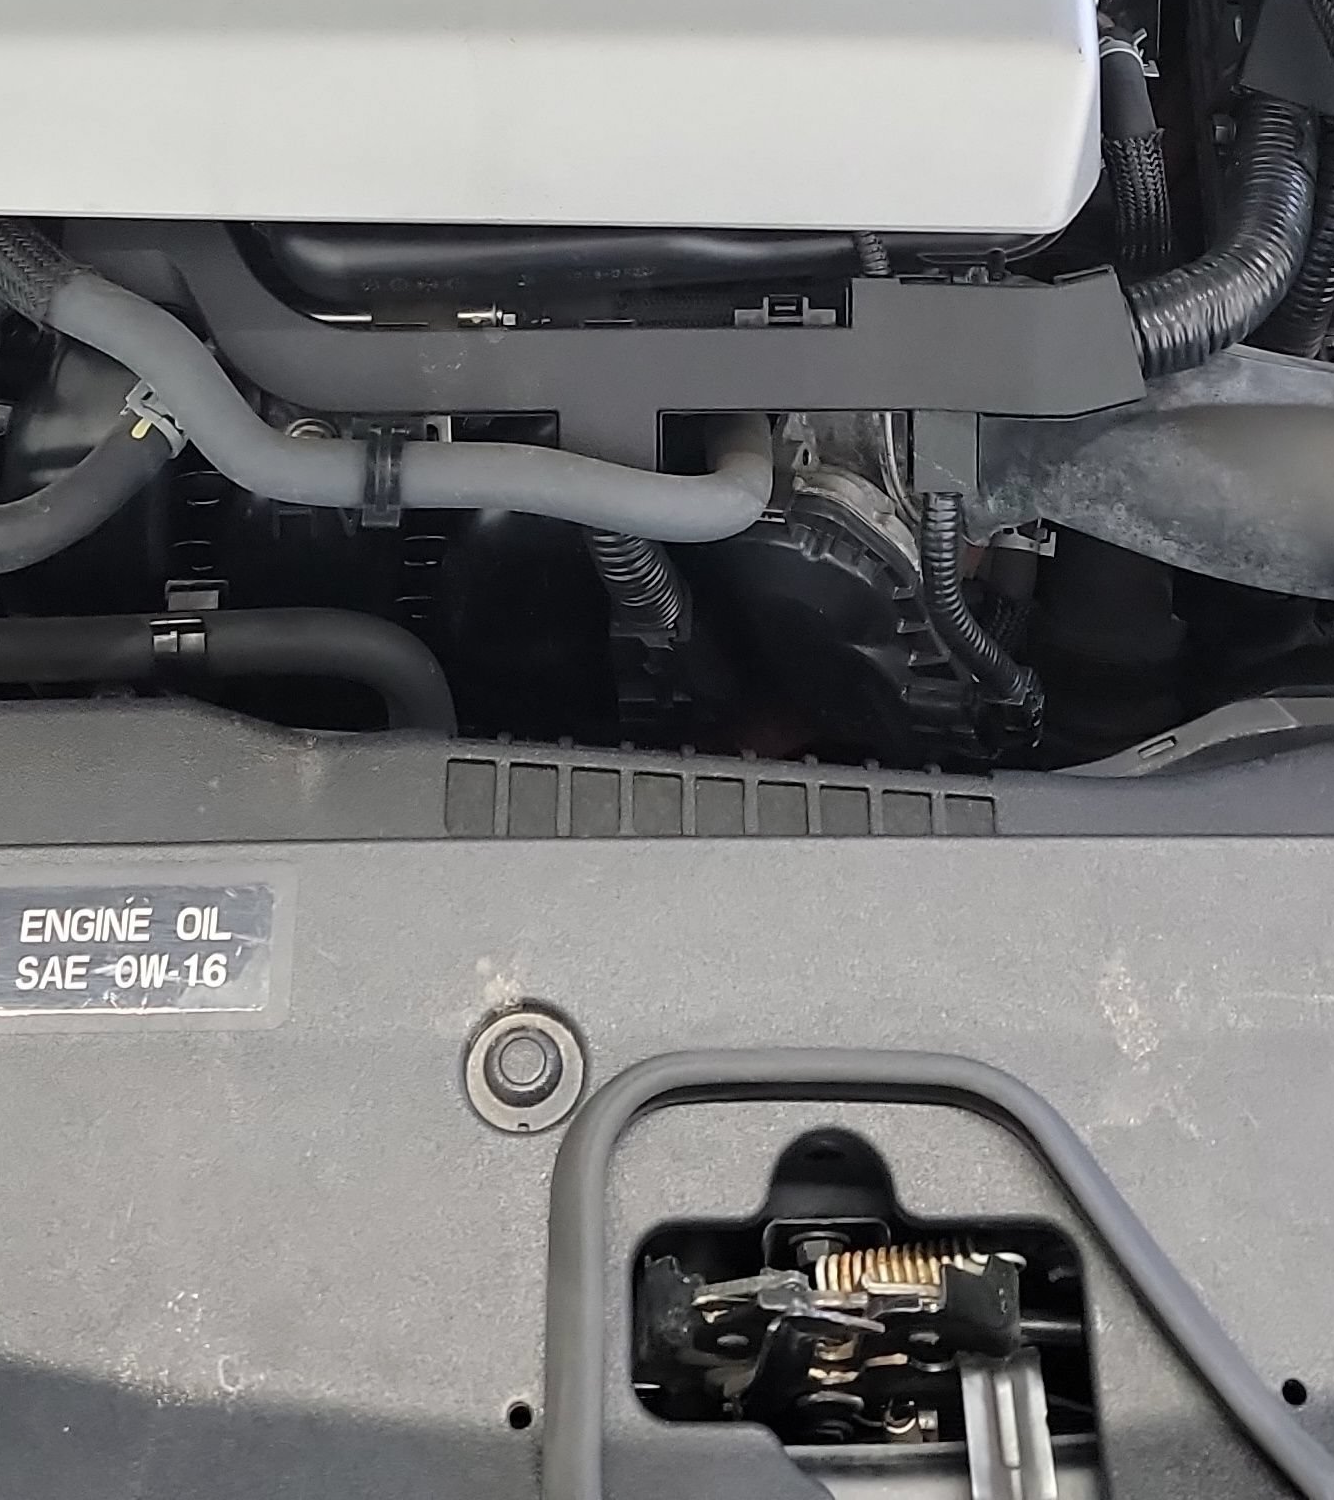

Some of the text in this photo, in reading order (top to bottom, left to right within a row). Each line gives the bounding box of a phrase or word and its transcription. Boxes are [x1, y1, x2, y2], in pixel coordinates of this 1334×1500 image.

[19, 906, 232, 943] ENGINE OIL
[15, 952, 229, 991] SAE 0W-16
